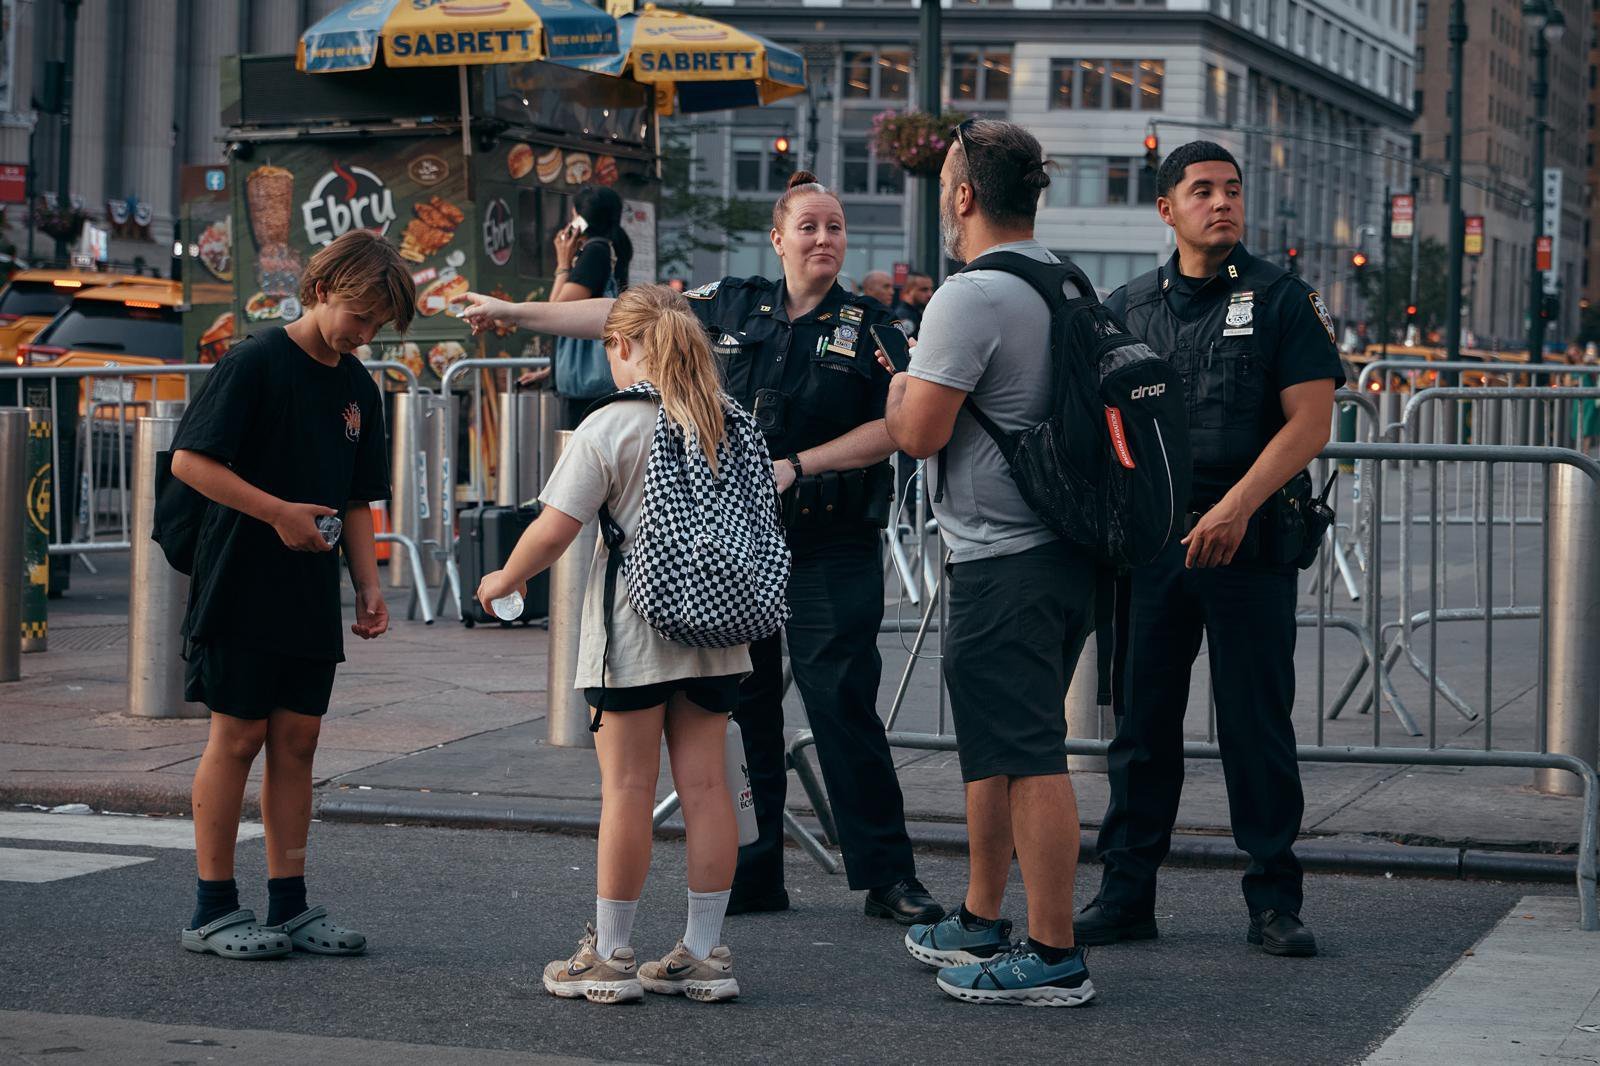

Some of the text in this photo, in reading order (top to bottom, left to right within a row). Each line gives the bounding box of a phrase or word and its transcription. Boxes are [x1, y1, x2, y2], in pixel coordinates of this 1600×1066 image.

[393, 29, 534, 57] SABRETT
[640, 52, 756, 72] SABRETT
[302, 188, 396, 245] Ebru
[1131, 382, 1166, 400] drop
